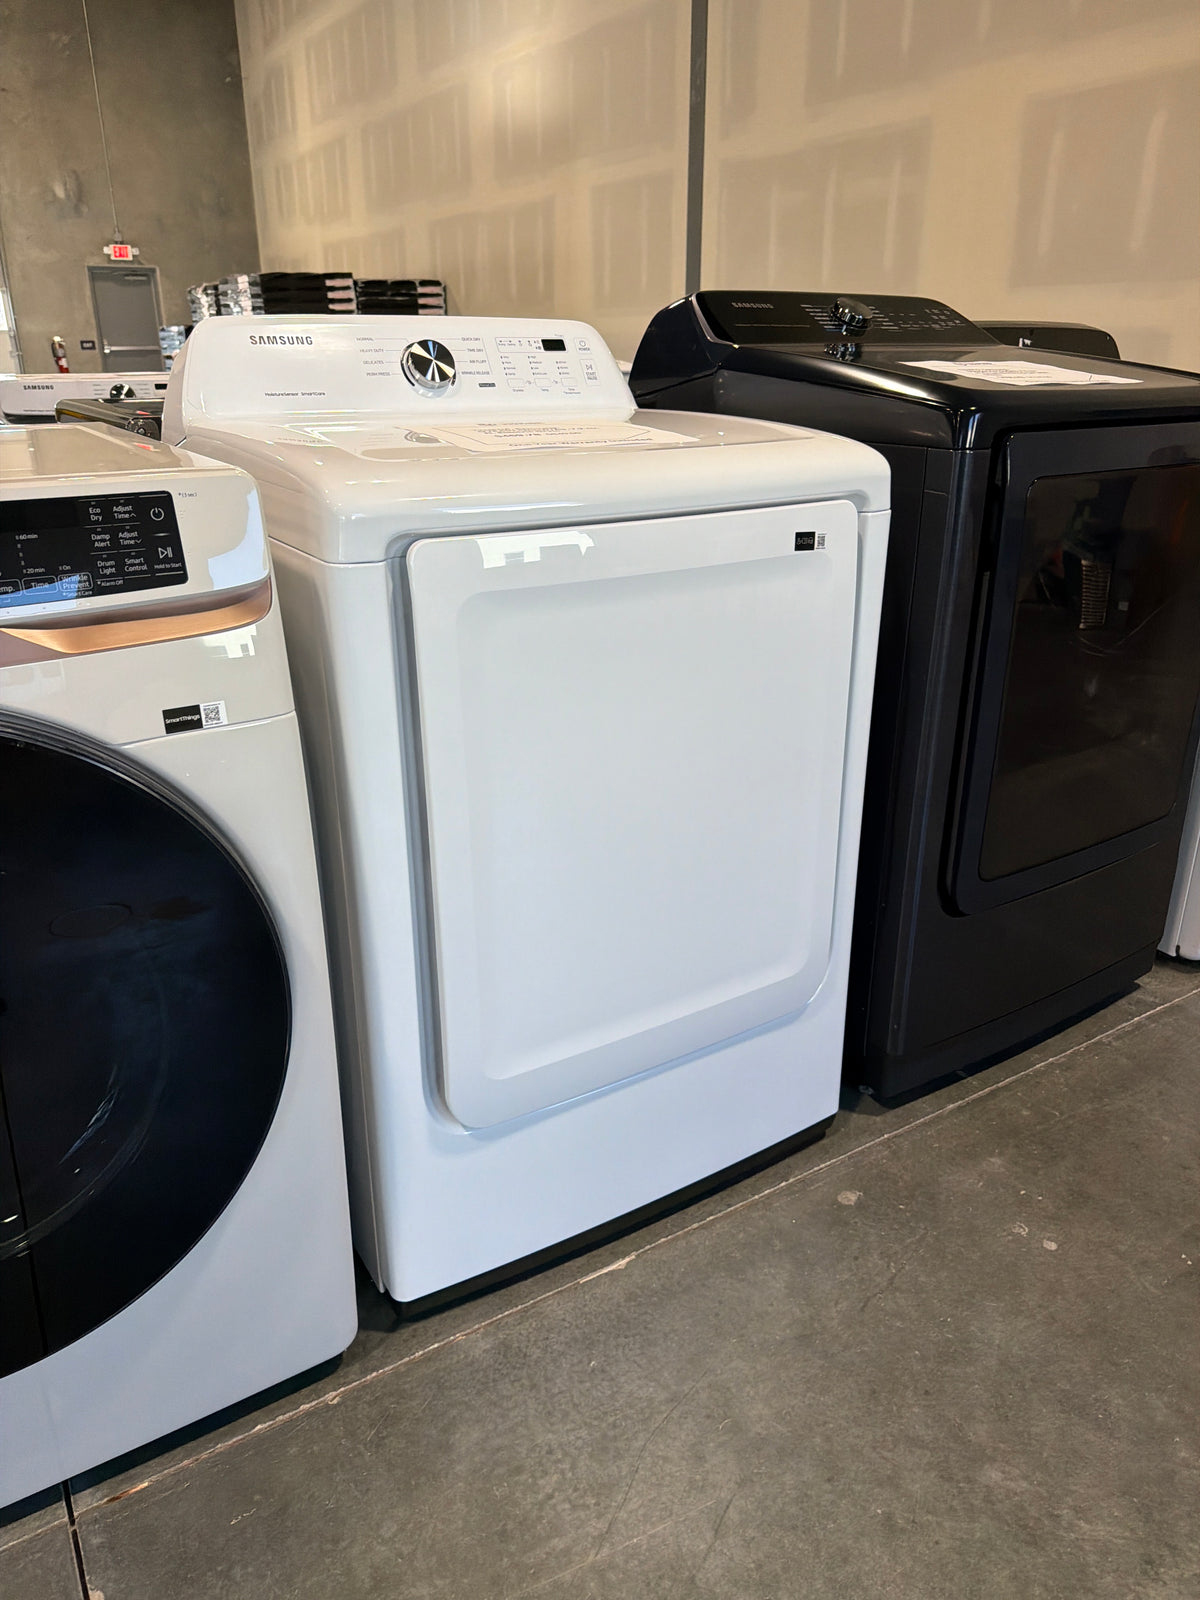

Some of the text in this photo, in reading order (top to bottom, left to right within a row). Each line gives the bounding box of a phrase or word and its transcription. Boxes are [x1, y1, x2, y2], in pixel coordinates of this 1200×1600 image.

[249, 335, 313, 345] SAMSUNG
[113, 505, 133, 513] Adjust
[91, 533, 111, 541] Damp
[118, 531, 139, 539] Adjust
[99, 567, 116, 575] Light
[30, 581, 49, 589] Time
[62, 581, 89, 590] Prevent
[165, 714, 200, 724] SmartThings
